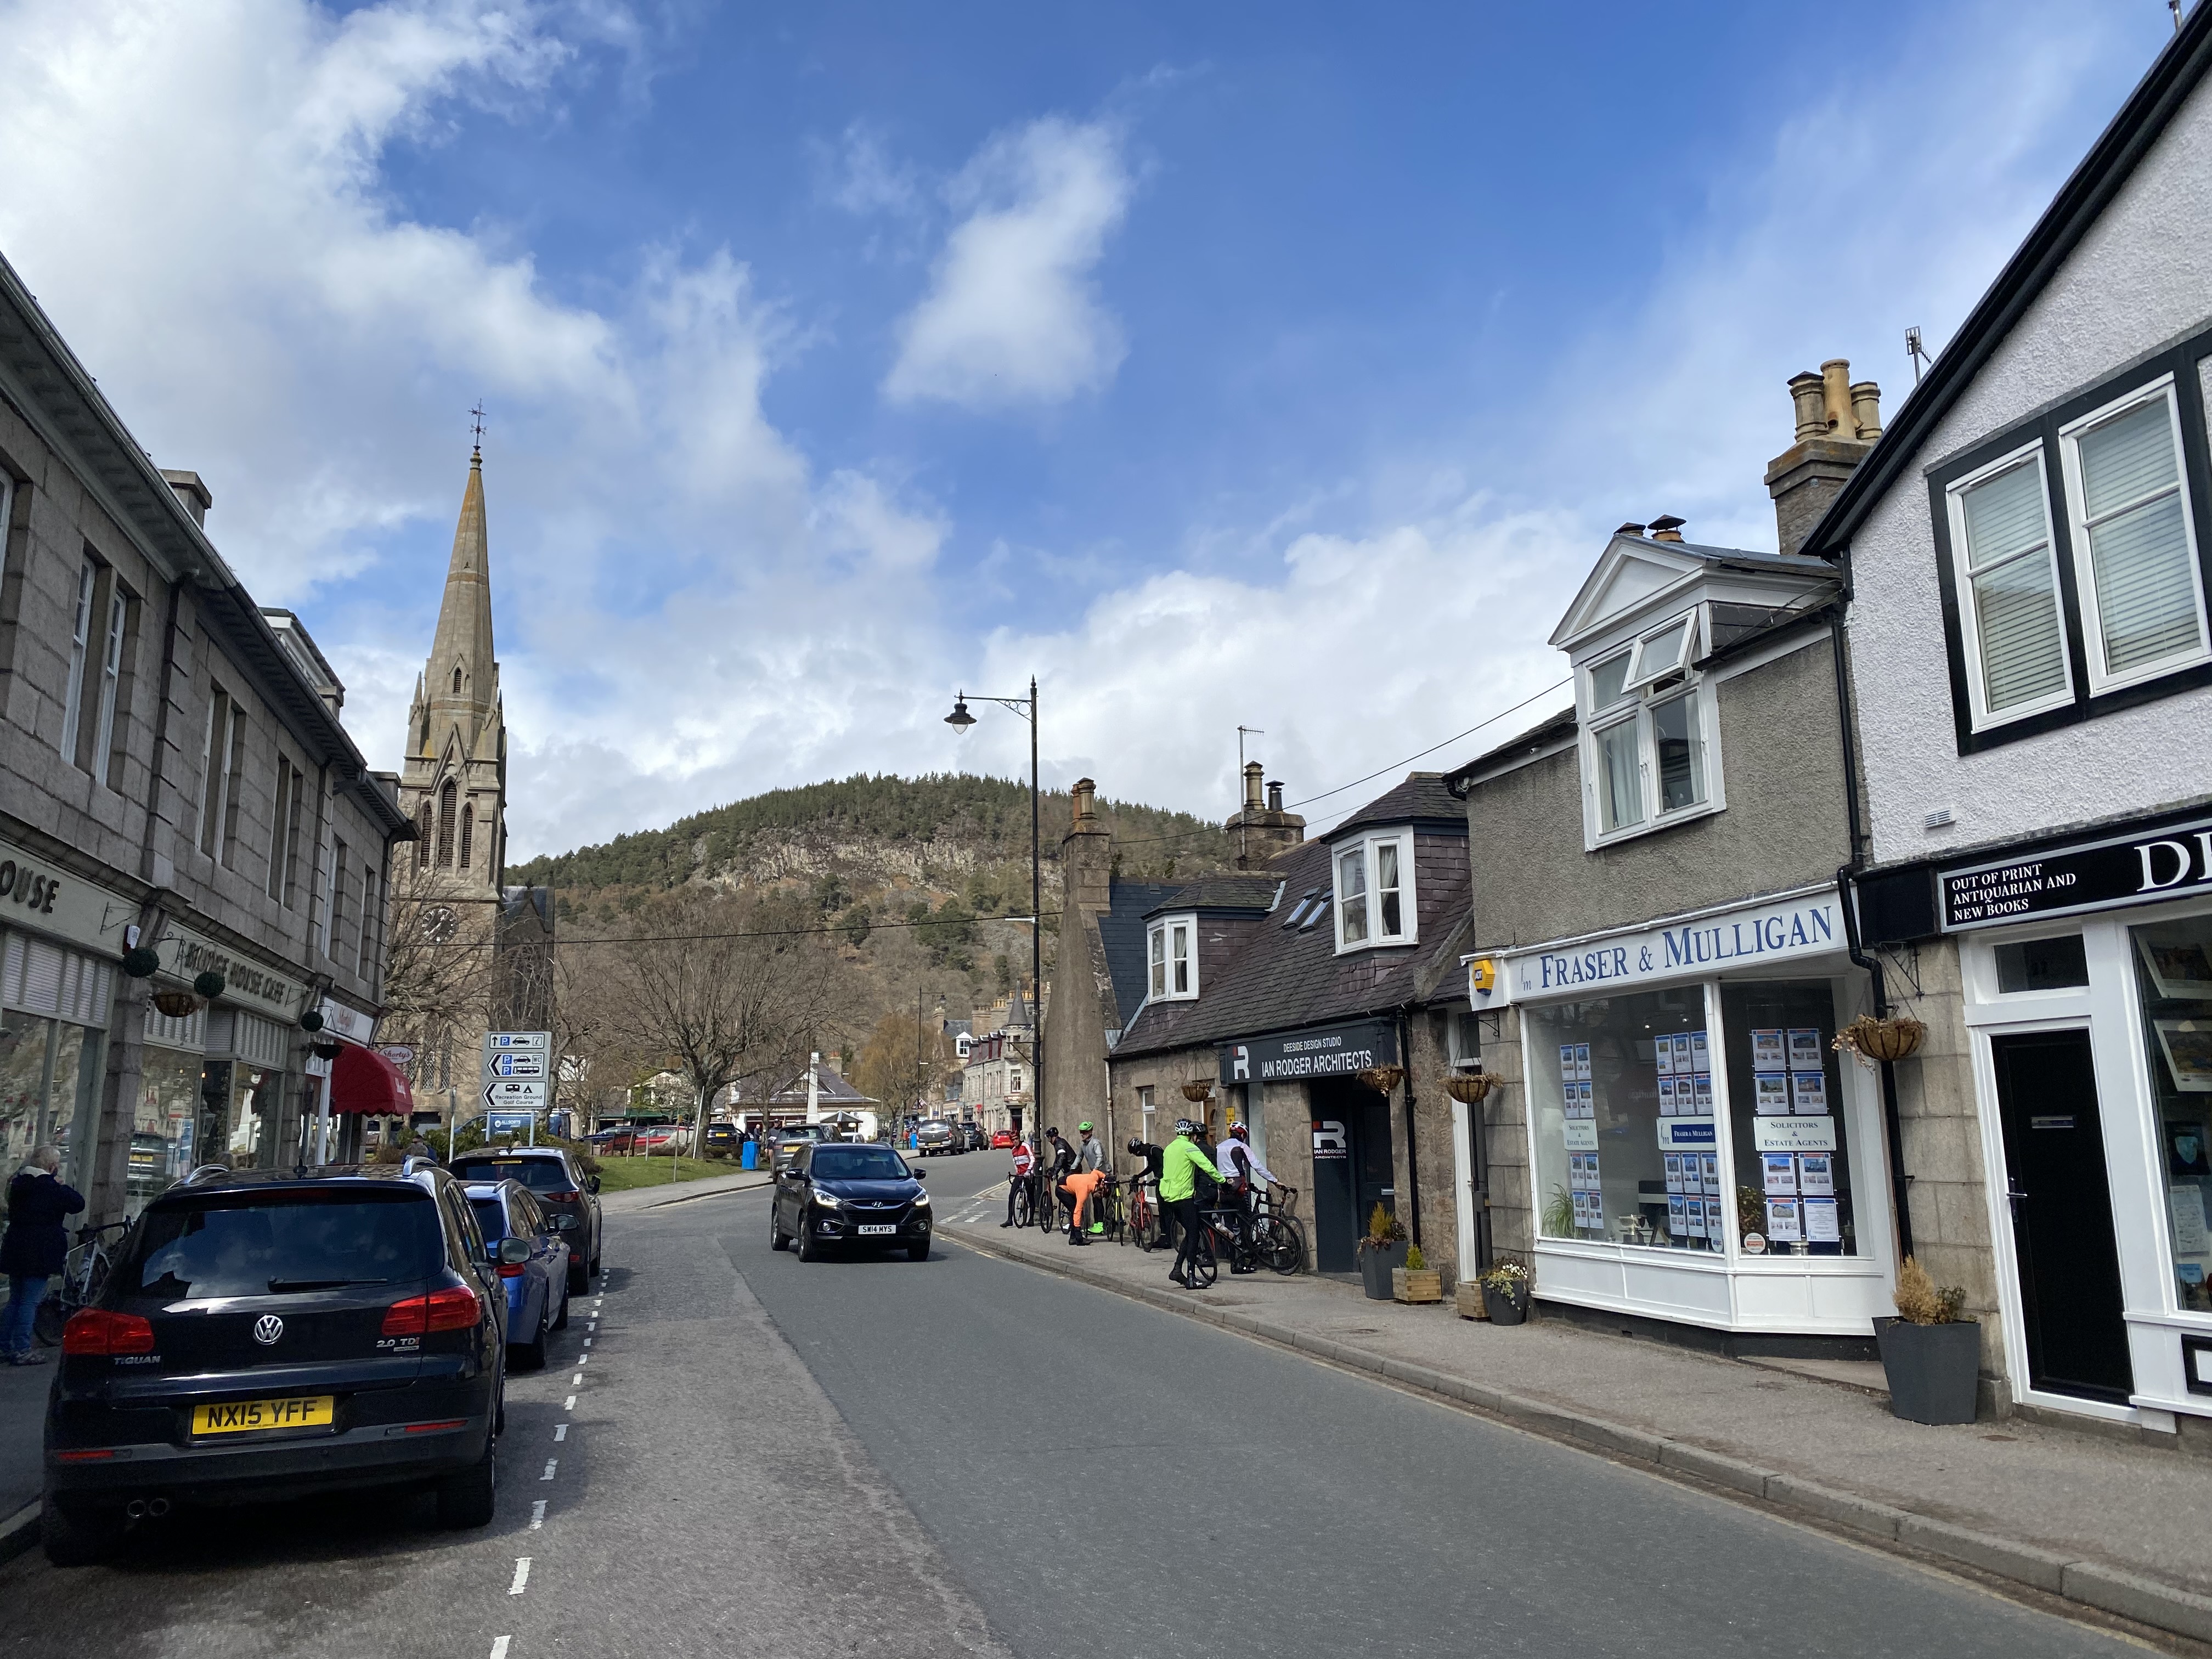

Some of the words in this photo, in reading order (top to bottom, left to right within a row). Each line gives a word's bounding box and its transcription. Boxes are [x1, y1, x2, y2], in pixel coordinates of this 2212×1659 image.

[1952, 876, 1978, 890] OUT
[1981, 872, 1998, 885] OF
[2002, 864, 2042, 882] PRINT
[1953, 879, 2042, 905] ANTIQUARIAN
[2046, 873, 2076, 889] AND
[1954, 906, 1983, 921] NEW
[1987, 898, 2028, 916] BOOKS
[1540, 947, 1629, 988] FRASER
[1639, 945, 1654, 972] &
[1662, 906, 1831, 968] MULLIGAN
[228, 961, 264, 995] HOUSE
[383, 1049, 410, 1060] Shorty's
[1283, 1041, 1304, 1053] DEESIDE
[1304, 1039, 1322, 1051] DESIGN
[1322, 1036, 1341, 1048] STUDIO
[1262, 1060, 1274, 1077] IAN
[1276, 1056, 1311, 1076] RODGER
[1313, 1049, 1372, 1073] ARCHITECTS
[400, 1337, 420, 1346] TDI
[114, 1355, 161, 1365] TIGUAN
[207, 1403, 262, 1428] NX15
[271, 1400, 317, 1423] YFF
